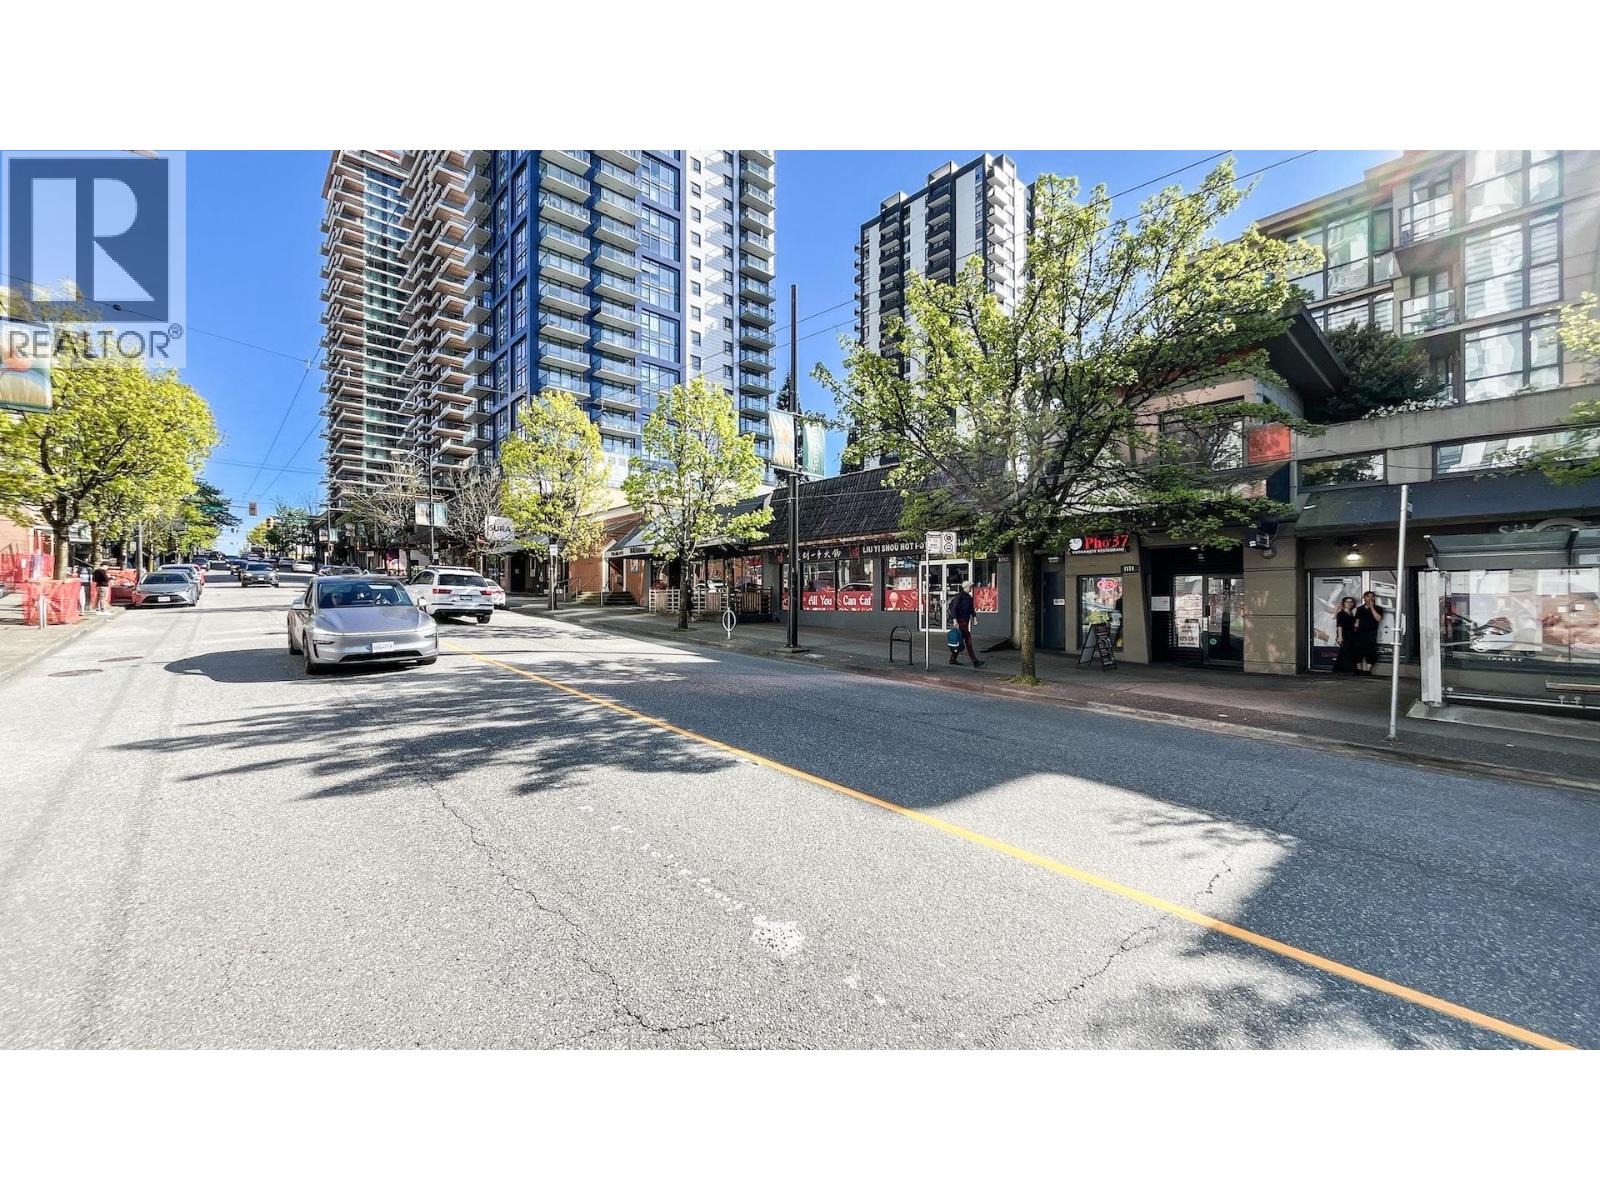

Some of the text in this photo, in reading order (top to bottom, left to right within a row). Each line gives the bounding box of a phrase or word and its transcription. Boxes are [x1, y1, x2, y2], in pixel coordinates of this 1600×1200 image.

[488, 525, 511, 533] SURA
[1112, 533, 1130, 548] 37
[862, 546, 873, 554] LIU
[874, 545, 881, 553] YI
[881, 543, 899, 552] SHOU
[900, 542, 914, 551] HOT
[808, 594, 872, 606] All You Can Eat
